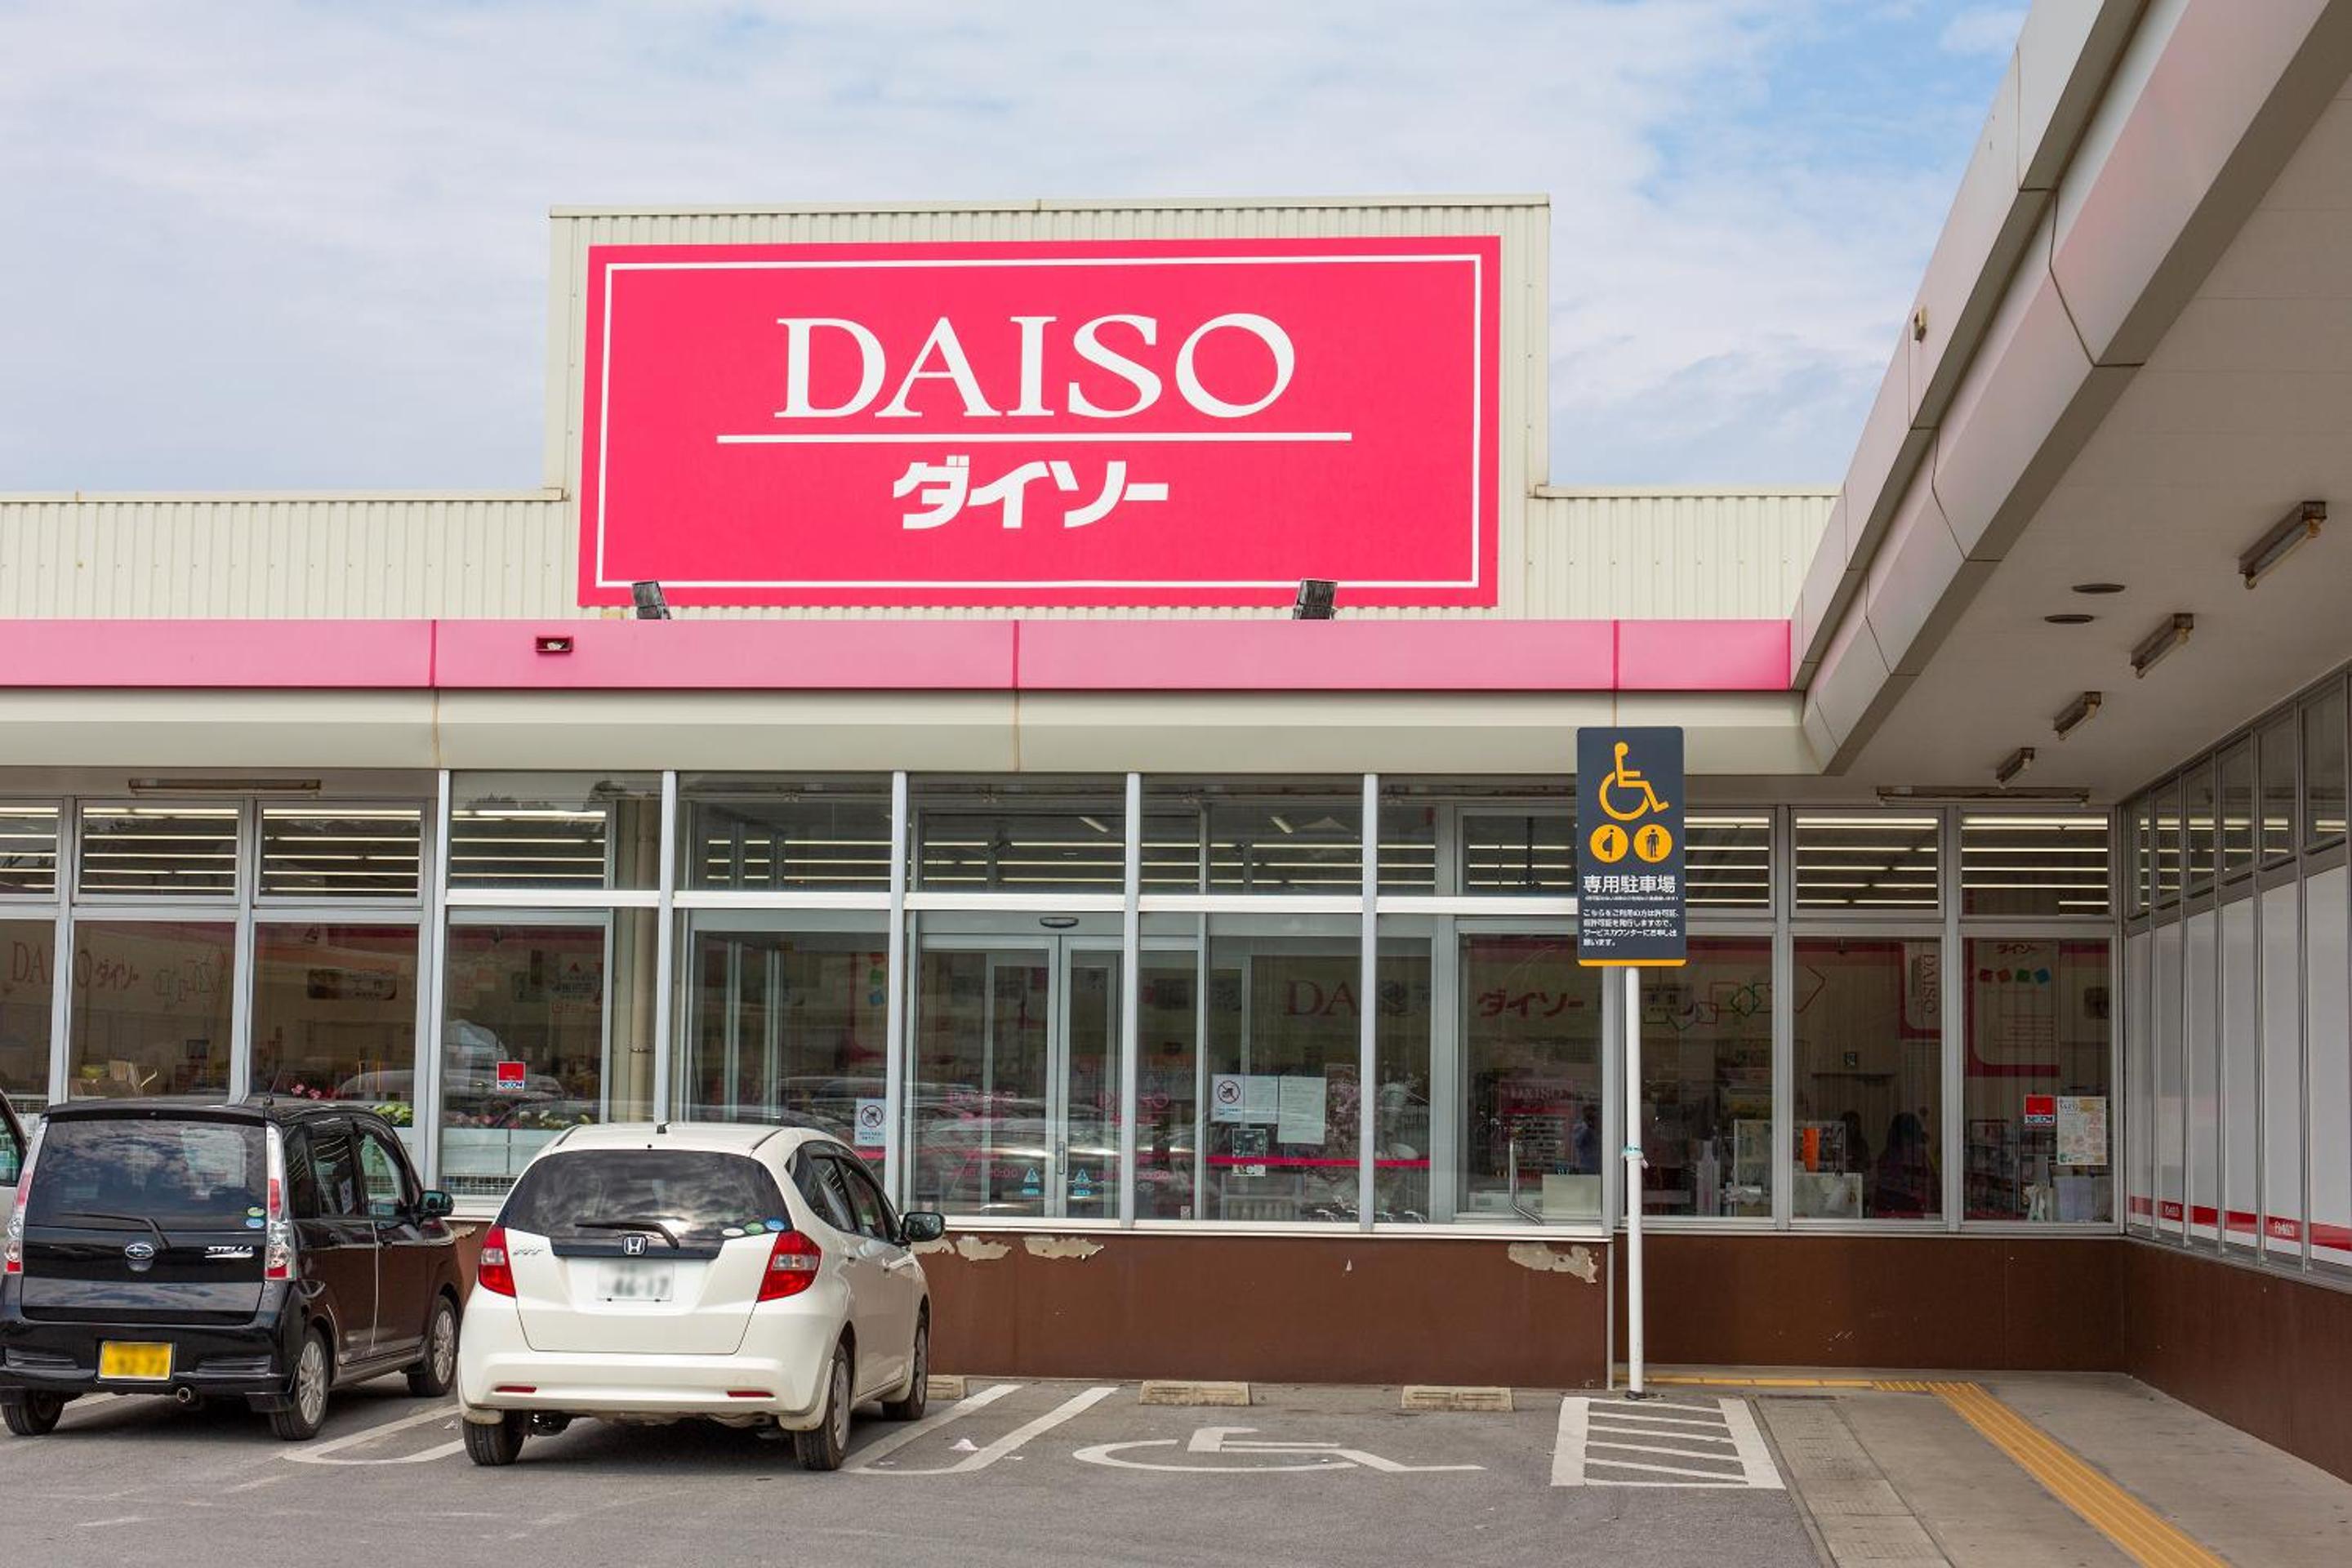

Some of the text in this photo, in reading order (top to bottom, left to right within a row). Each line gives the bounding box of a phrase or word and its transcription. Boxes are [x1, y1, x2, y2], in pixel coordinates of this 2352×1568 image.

[773, 313, 1295, 418] DAISO
[893, 454, 1169, 530] ダイソー
[1583, 875, 1677, 893] 専用駐車場
[1477, 989, 1584, 1018] ダイソー
[204, 1245, 254, 1255] STELLA
